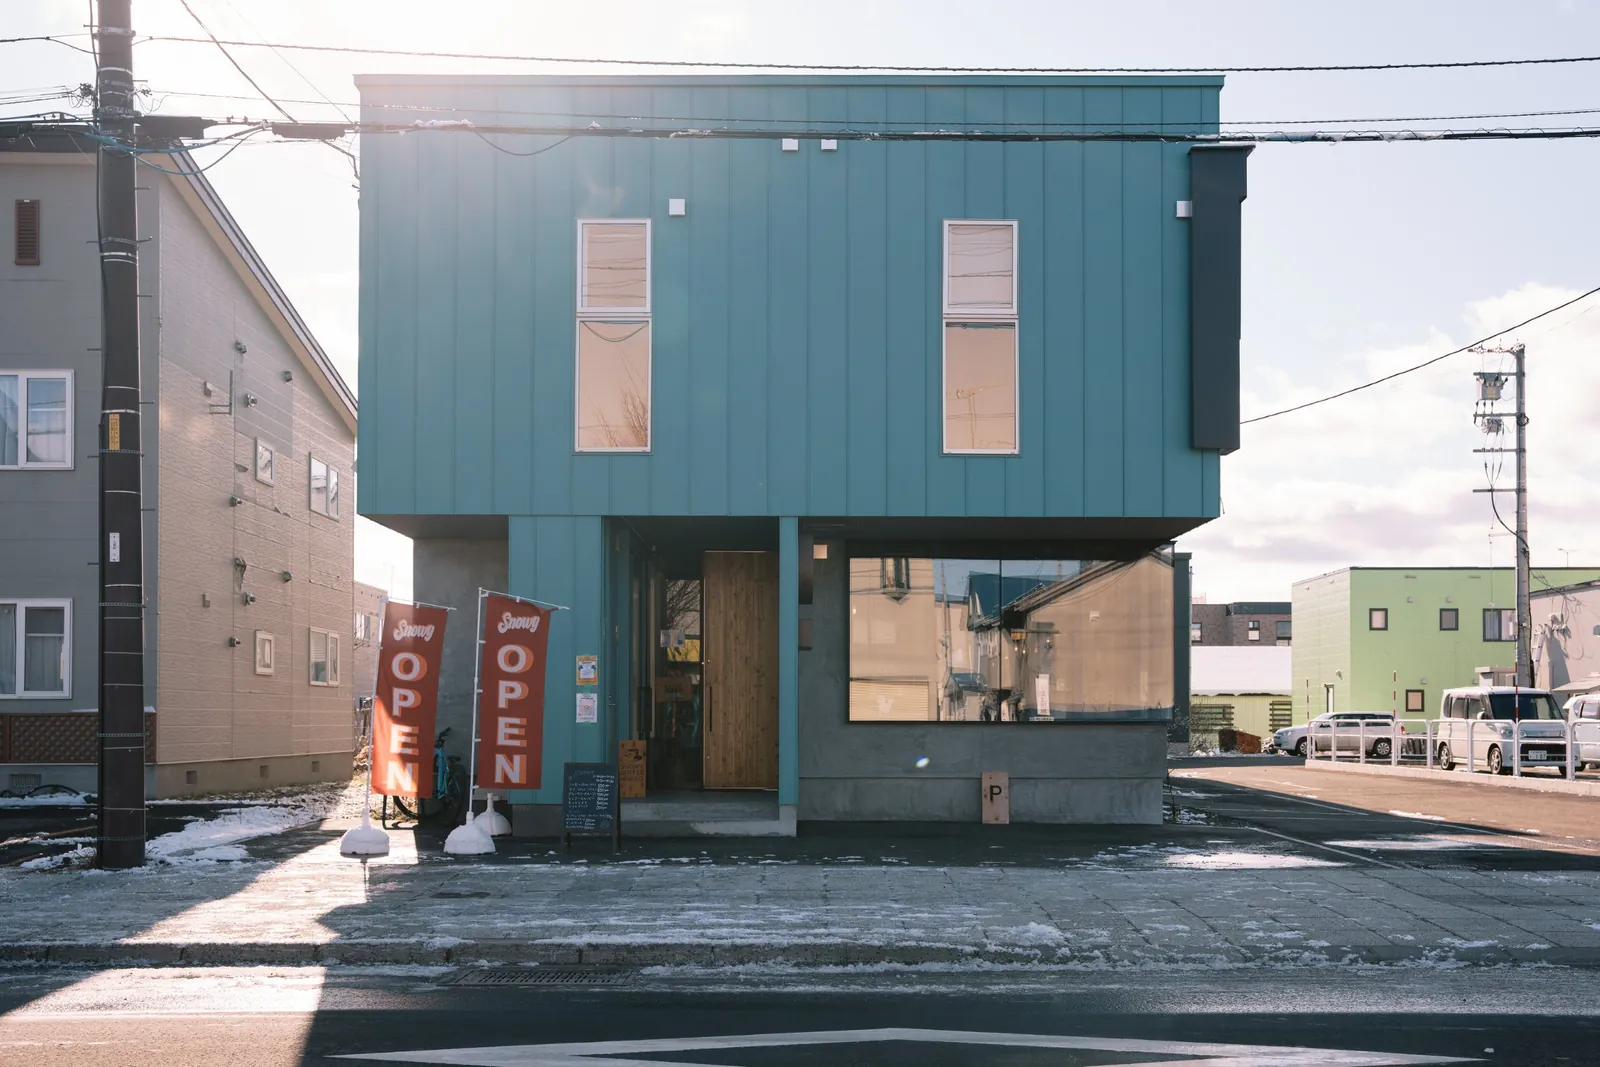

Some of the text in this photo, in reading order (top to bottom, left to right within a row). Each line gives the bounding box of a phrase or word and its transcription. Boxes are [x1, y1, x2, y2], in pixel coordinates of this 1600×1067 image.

[393, 619, 435, 642] Snowy
[497, 611, 540, 634] Snowy
[386, 652, 428, 792] OPEN
[494, 644, 534, 785] OPEN
[989, 785, 1002, 802] P
